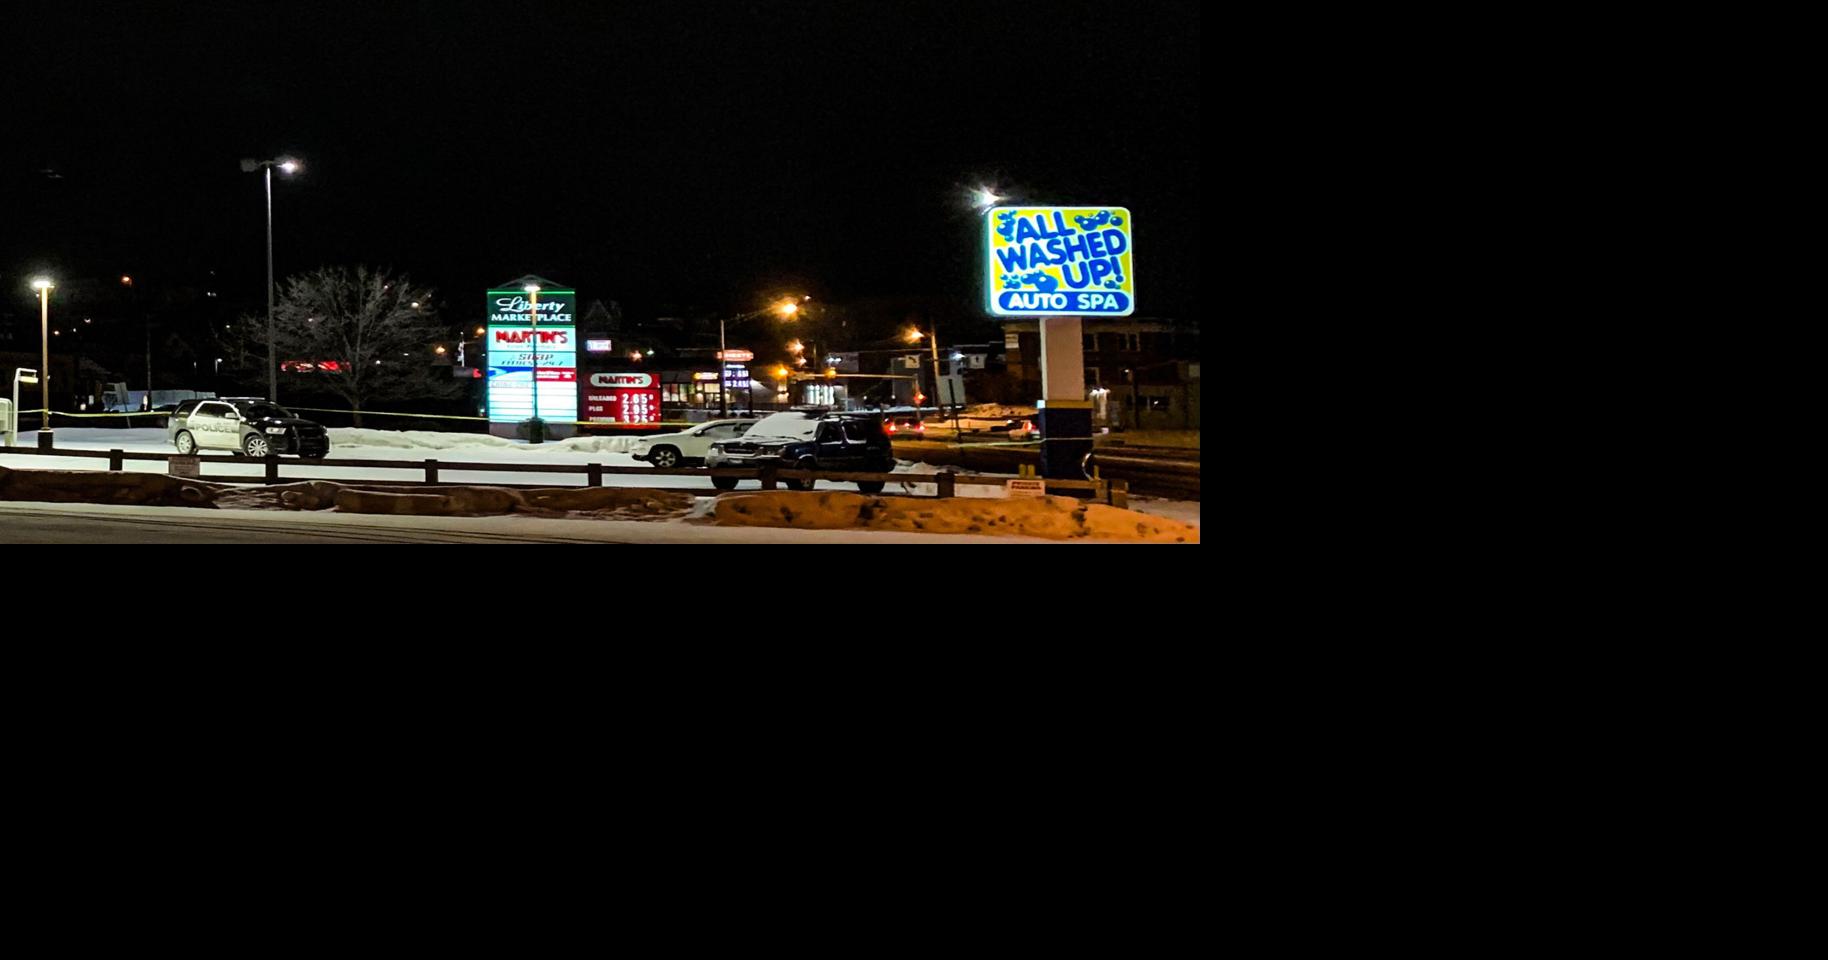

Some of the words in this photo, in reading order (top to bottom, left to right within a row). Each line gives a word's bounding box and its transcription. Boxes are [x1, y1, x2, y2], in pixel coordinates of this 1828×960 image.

[1016, 211, 1076, 244] ALL
[996, 229, 1127, 273] WASHED
[1062, 256, 1124, 289] UP!
[496, 296, 565, 312] Liberty
[1008, 293, 1067, 309] AUTO
[1077, 293, 1119, 310] SPA
[491, 313, 572, 321] MARKEPLACE
[195, 423, 231, 433] POLICE
